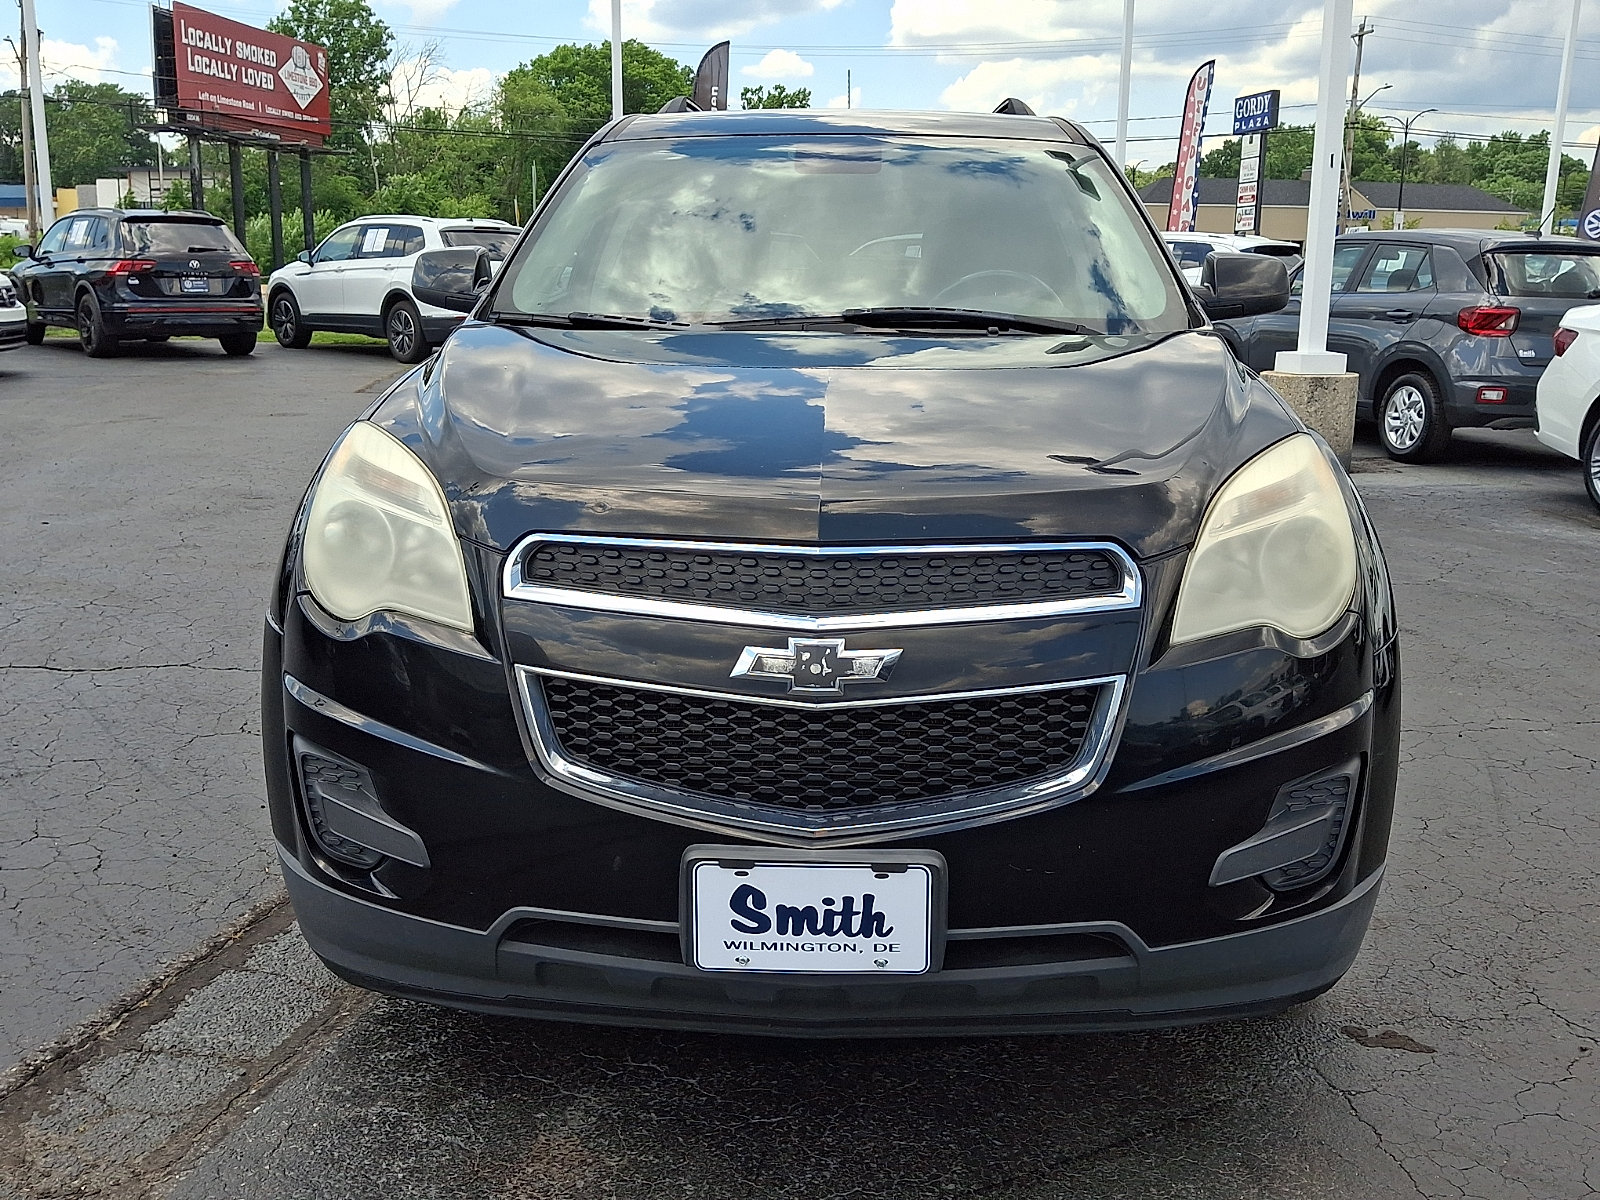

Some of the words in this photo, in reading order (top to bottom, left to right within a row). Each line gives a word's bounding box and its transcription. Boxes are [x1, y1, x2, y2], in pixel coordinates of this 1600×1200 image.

[180, 19, 232, 55] LOCALLY
[236, 41, 277, 68] SMOKED
[187, 47, 238, 82] LOCALLY
[242, 66, 274, 91] LOVED
[198, 91, 209, 101] Left
[217, 94, 242, 108] Limestone
[242, 99, 255, 111] Road
[1235, 93, 1272, 119] GORDY
[1234, 116, 1270, 131] PLAZA
[729, 883, 893, 938] Smith
[723, 940, 864, 954] WILMINGTON,
[873, 943, 901, 953] DE
